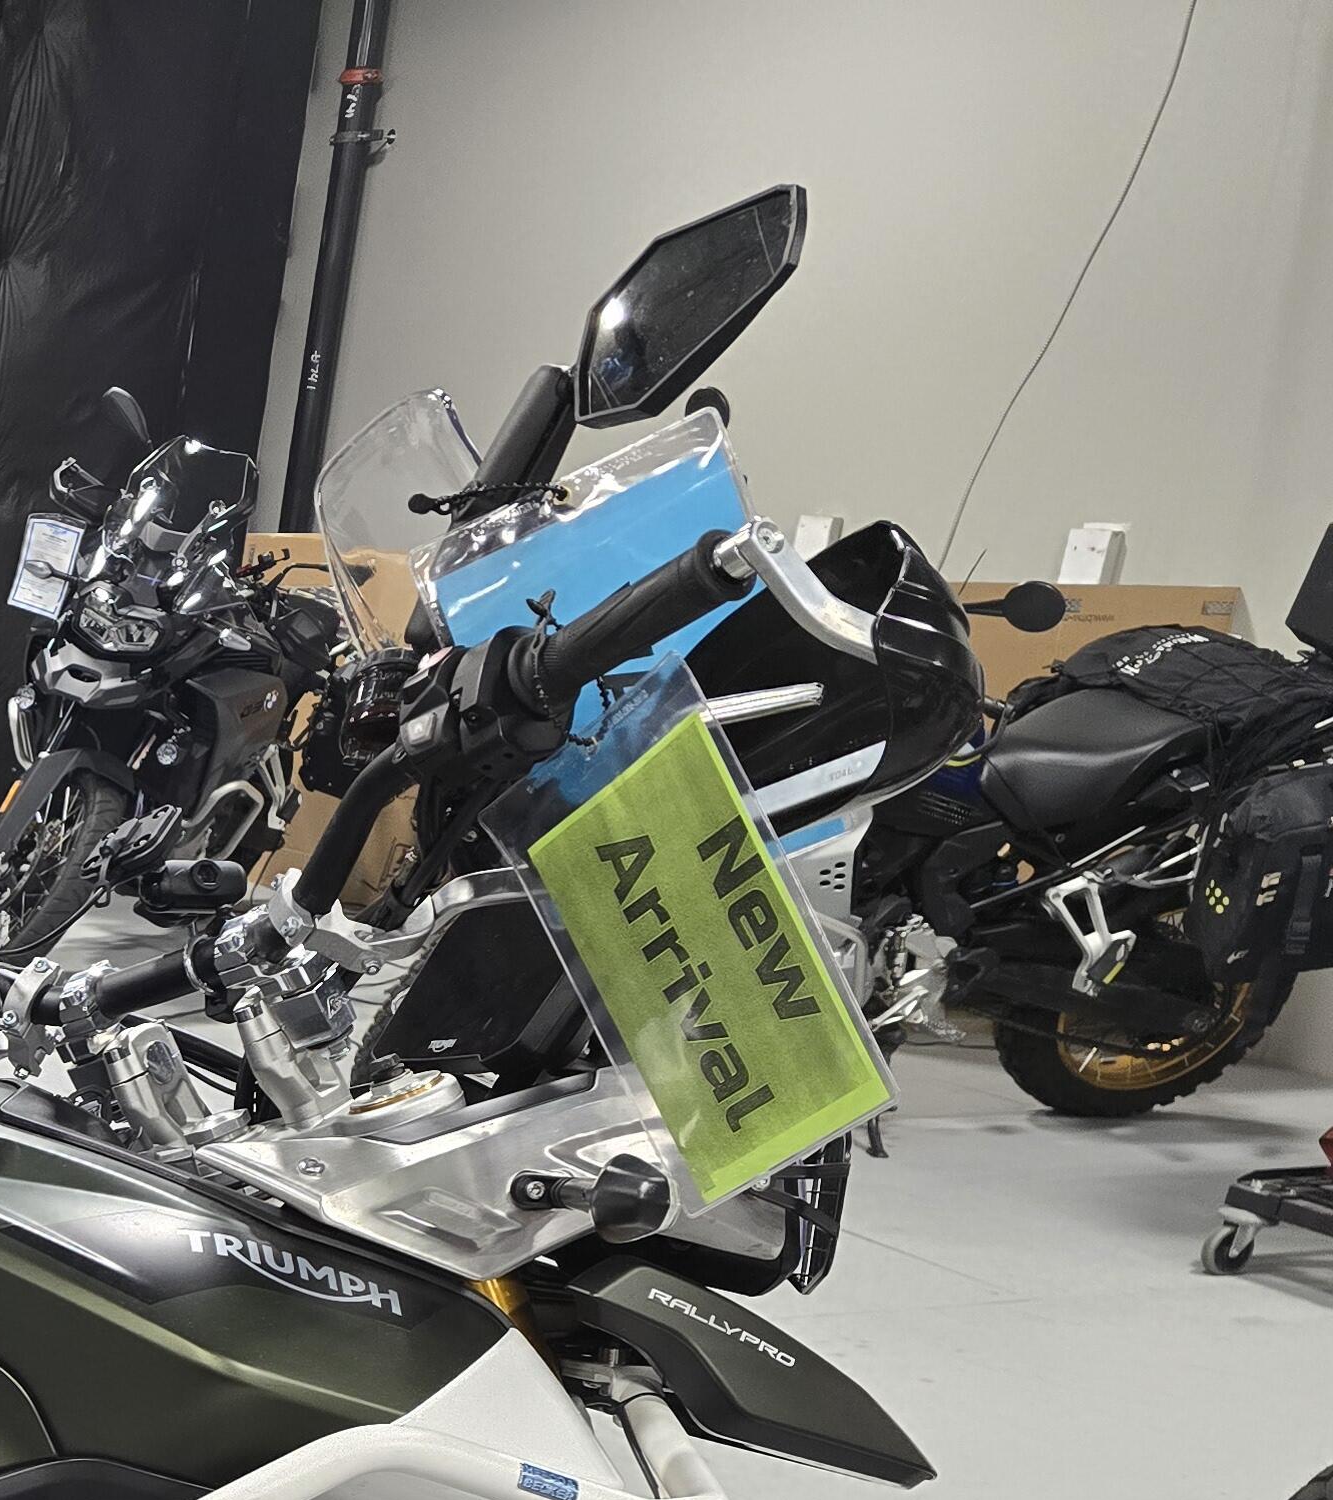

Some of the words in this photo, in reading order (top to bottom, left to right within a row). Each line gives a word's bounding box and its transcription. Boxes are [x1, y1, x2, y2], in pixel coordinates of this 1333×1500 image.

[594, 834, 775, 1133] Arrival
[696, 815, 821, 1021] New
[179, 1228, 403, 1317] TRIUMPH
